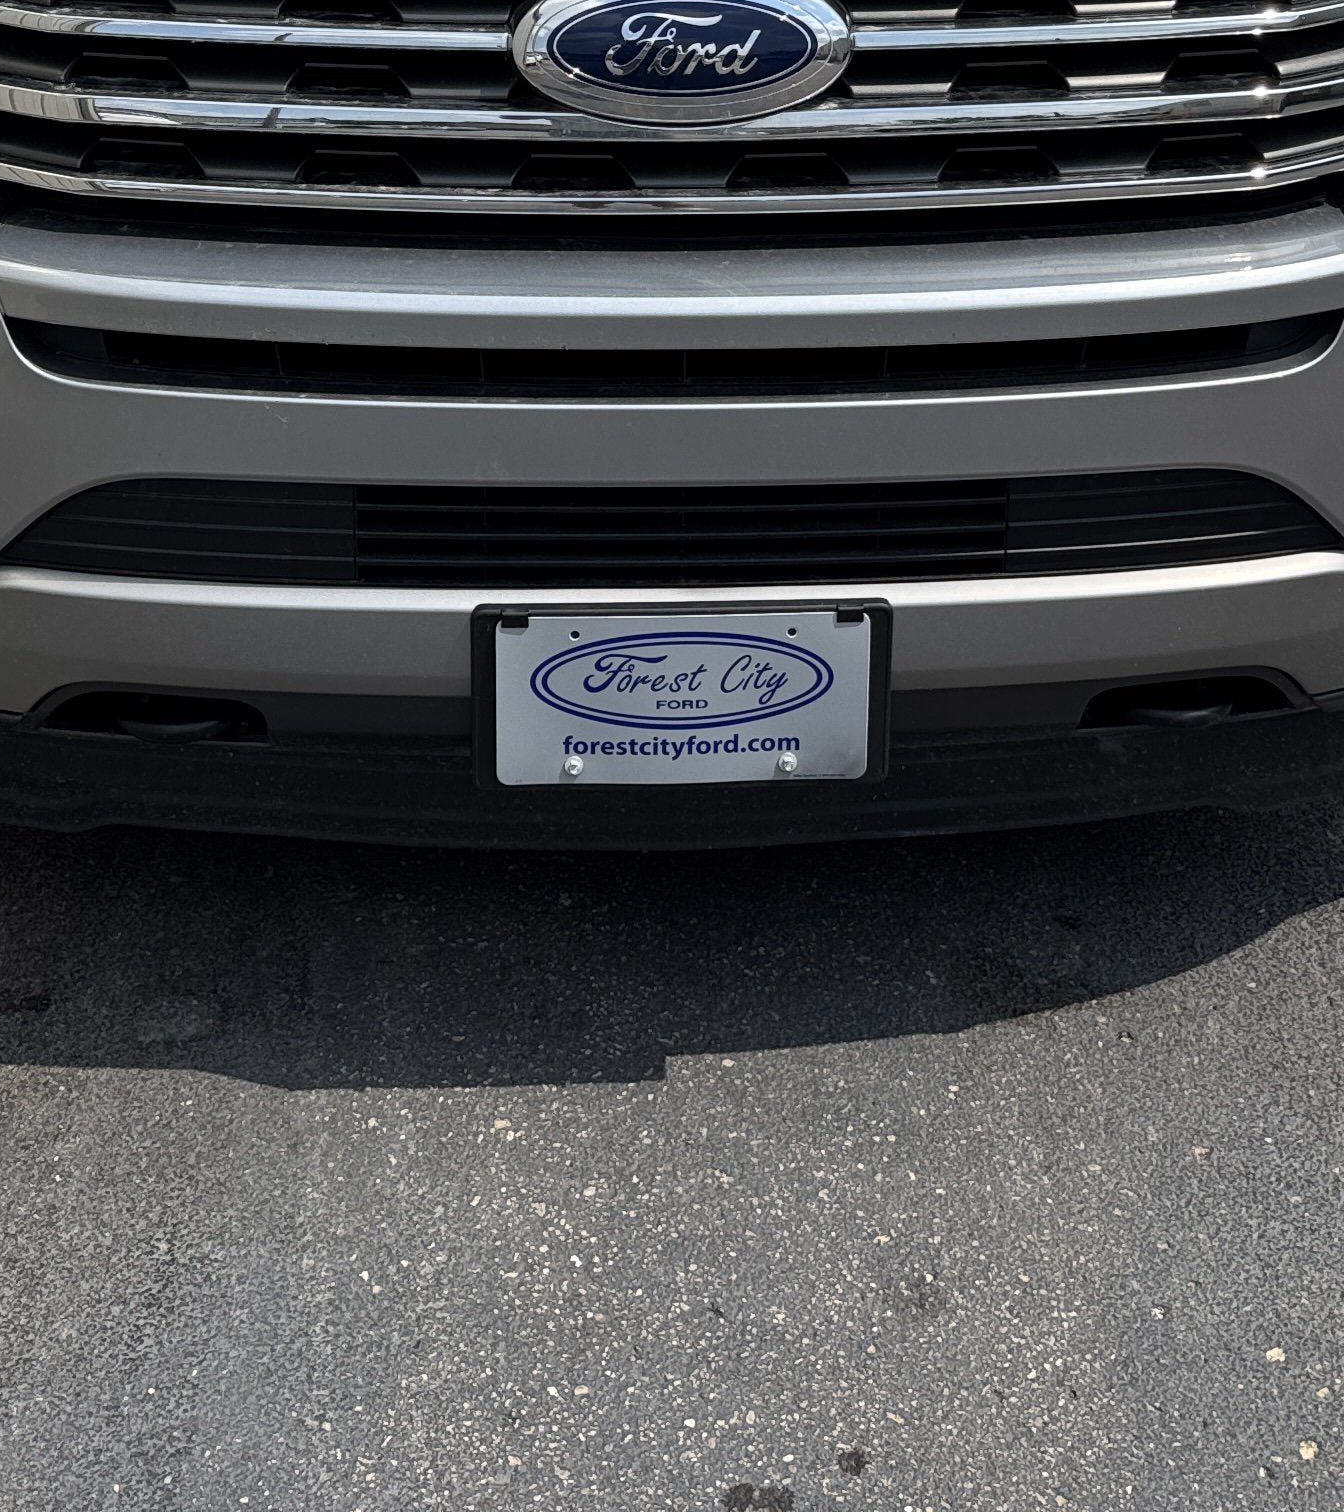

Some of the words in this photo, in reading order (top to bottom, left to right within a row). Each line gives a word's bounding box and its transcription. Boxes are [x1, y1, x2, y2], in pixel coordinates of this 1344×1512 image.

[605, 12, 761, 76] Ford
[582, 653, 708, 694] Forest
[719, 653, 789, 706] City
[655, 698, 709, 710] FORD
[562, 733, 801, 761] forestcityford.com
